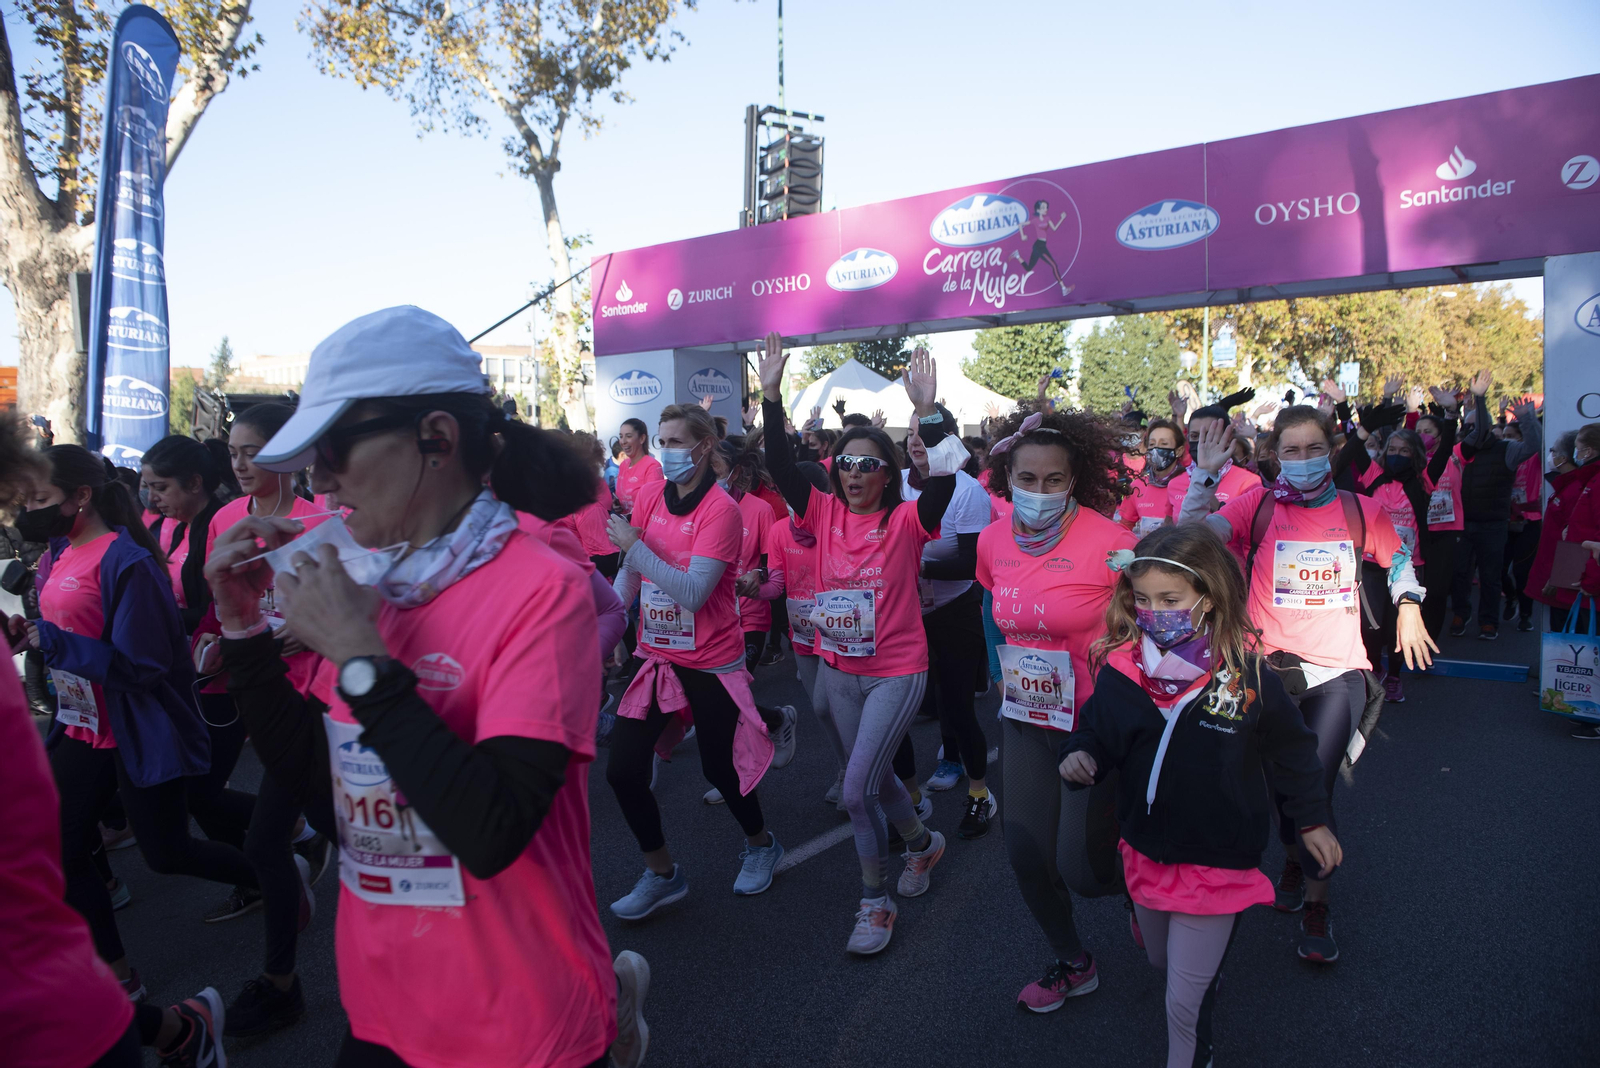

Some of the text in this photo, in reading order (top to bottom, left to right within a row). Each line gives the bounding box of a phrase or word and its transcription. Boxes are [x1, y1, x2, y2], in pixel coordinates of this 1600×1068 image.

[1400, 179, 1516, 209] Santander
[1254, 192, 1361, 226] OYSHO
[938, 212, 1020, 238] ASTURIANA
[1124, 218, 1212, 242] ASTURIANA
[922, 246, 1003, 276] Carrera
[833, 265, 892, 284] ASTURIANA
[751, 273, 811, 297] OYSHO
[942, 264, 1034, 309] de la Mujer
[688, 285, 734, 305] ZURICH
[601, 301, 649, 318] Santander
[613, 383, 659, 397] ASTURIANA
[691, 379, 731, 394] ASTURIANA
[994, 558, 1021, 568] OYSHO
[1300, 554, 1333, 562] ASTURIANA
[860, 567, 882, 577] POR
[1299, 568, 1332, 581] 016
[847, 579, 883, 588] TODAS
[1000, 586, 1019, 599] WE
[827, 602, 854, 610] ASTURIANA
[650, 608, 674, 622] 016
[826, 616, 853, 629] 016
[996, 618, 1048, 631] FOR A
[1006, 632, 1052, 642] EASON
[1568, 644, 1586, 666] Y
[1020, 660, 1050, 672] ASTURIANA
[1558, 666, 1592, 676] YBARRA
[1021, 677, 1052, 694] 016
[1028, 694, 1045, 703] 1430
